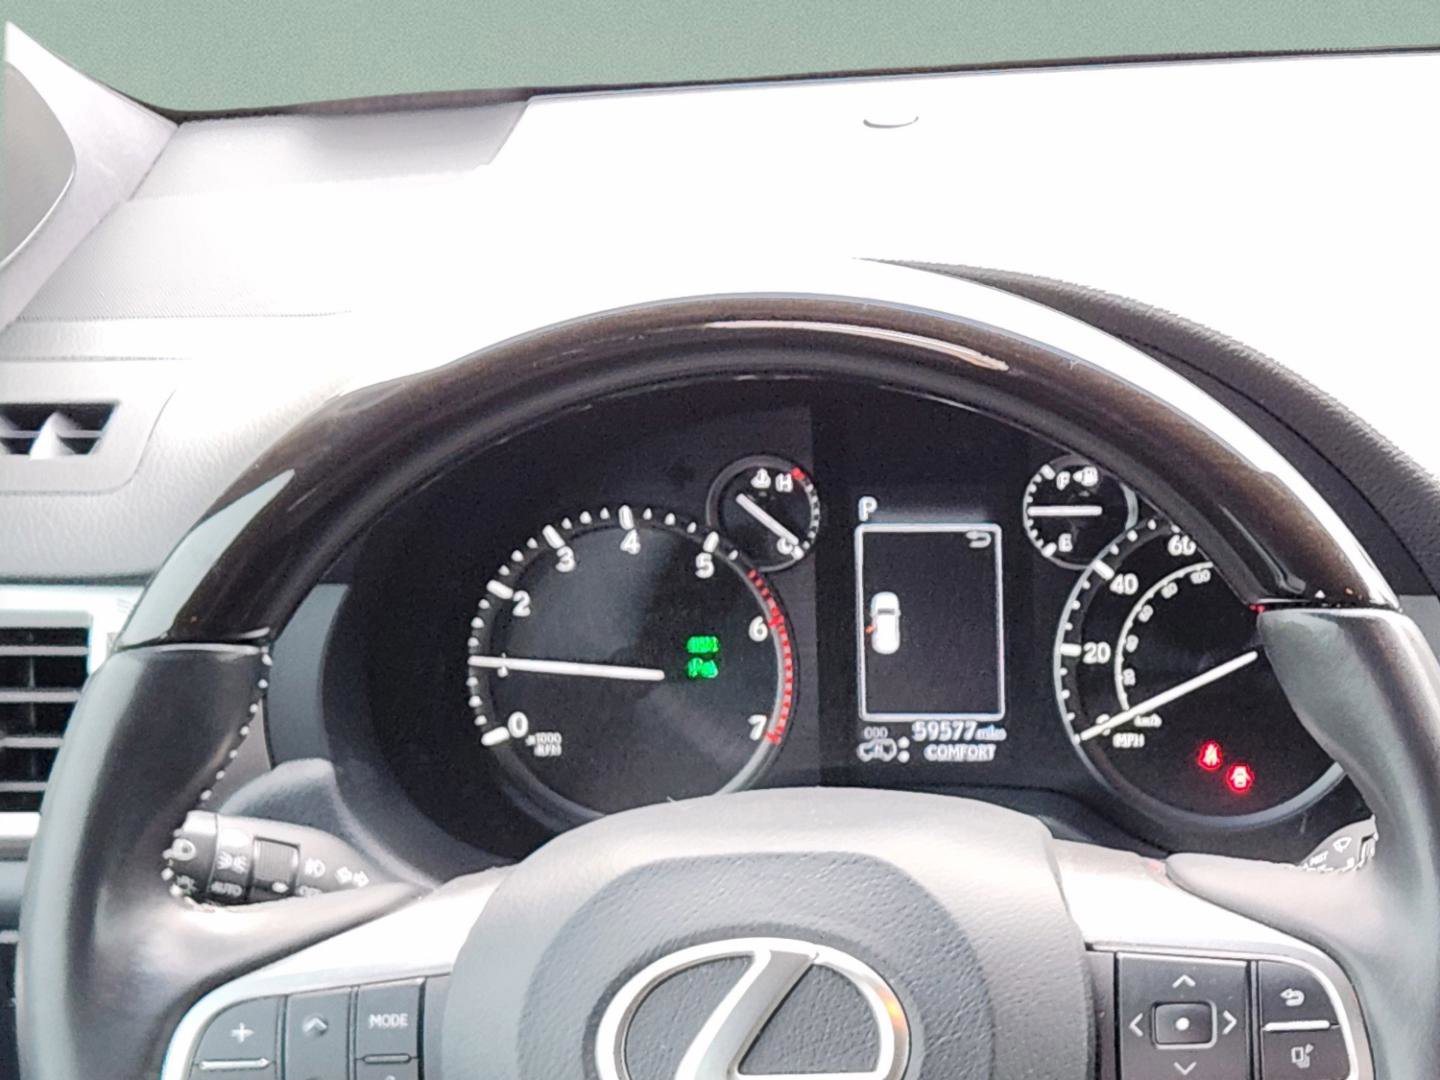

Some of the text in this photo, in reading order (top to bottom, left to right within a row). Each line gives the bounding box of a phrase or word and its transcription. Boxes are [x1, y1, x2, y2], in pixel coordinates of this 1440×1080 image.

[858, 495, 878, 522] P
[620, 528, 641, 555] 4
[555, 546, 576, 573] 3
[694, 552, 715, 579] 5
[1109, 572, 1139, 595] 40
[512, 590, 531, 616] 2
[748, 616, 768, 642] 6
[1082, 641, 1112, 664] 20
[508, 711, 529, 738] 0
[748, 714, 767, 740] 7
[911, 720, 977, 742] 59577
[923, 743, 997, 762] COMFORT
[369, 1013, 408, 1028] MODE
